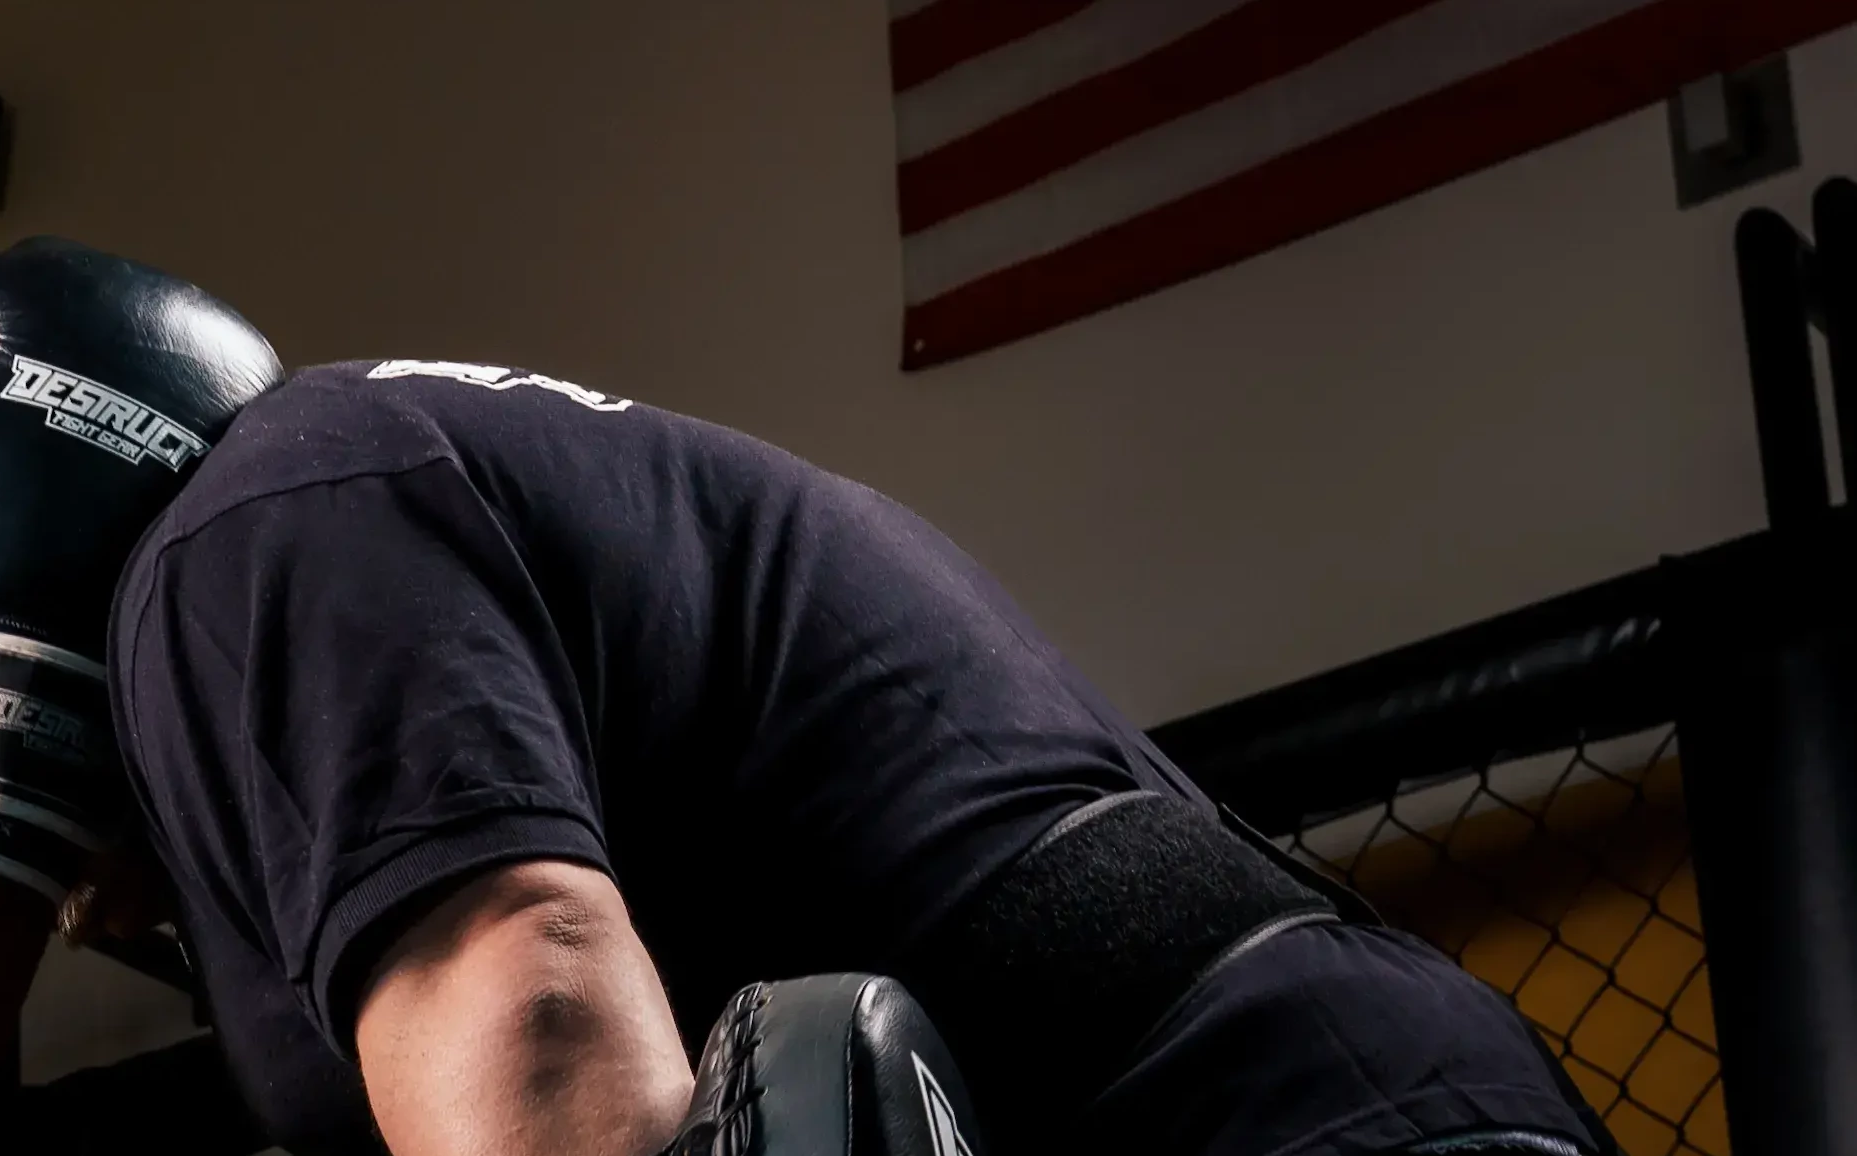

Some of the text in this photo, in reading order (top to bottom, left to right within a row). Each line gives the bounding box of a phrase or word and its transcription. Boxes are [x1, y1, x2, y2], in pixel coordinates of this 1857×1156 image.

[7, 357, 205, 467] DESTRUCT
[51, 409, 141, 459] FIGHT GEAR
